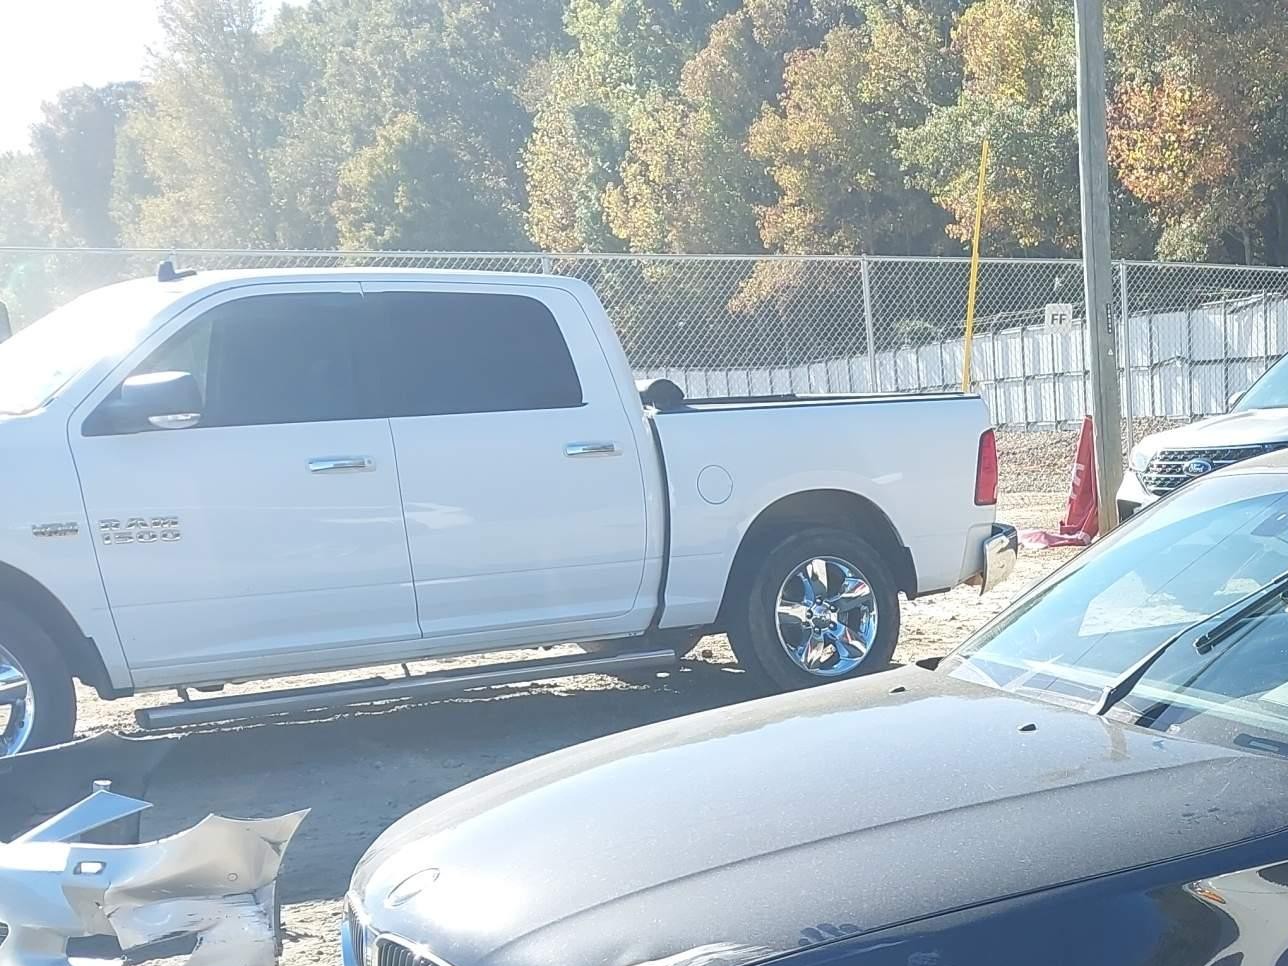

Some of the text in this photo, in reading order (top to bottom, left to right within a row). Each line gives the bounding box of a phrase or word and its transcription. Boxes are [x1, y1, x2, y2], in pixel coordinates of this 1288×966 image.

[1050, 313, 1067, 325] FF
[97, 516, 180, 530] RAM
[101, 530, 181, 545] 1500
